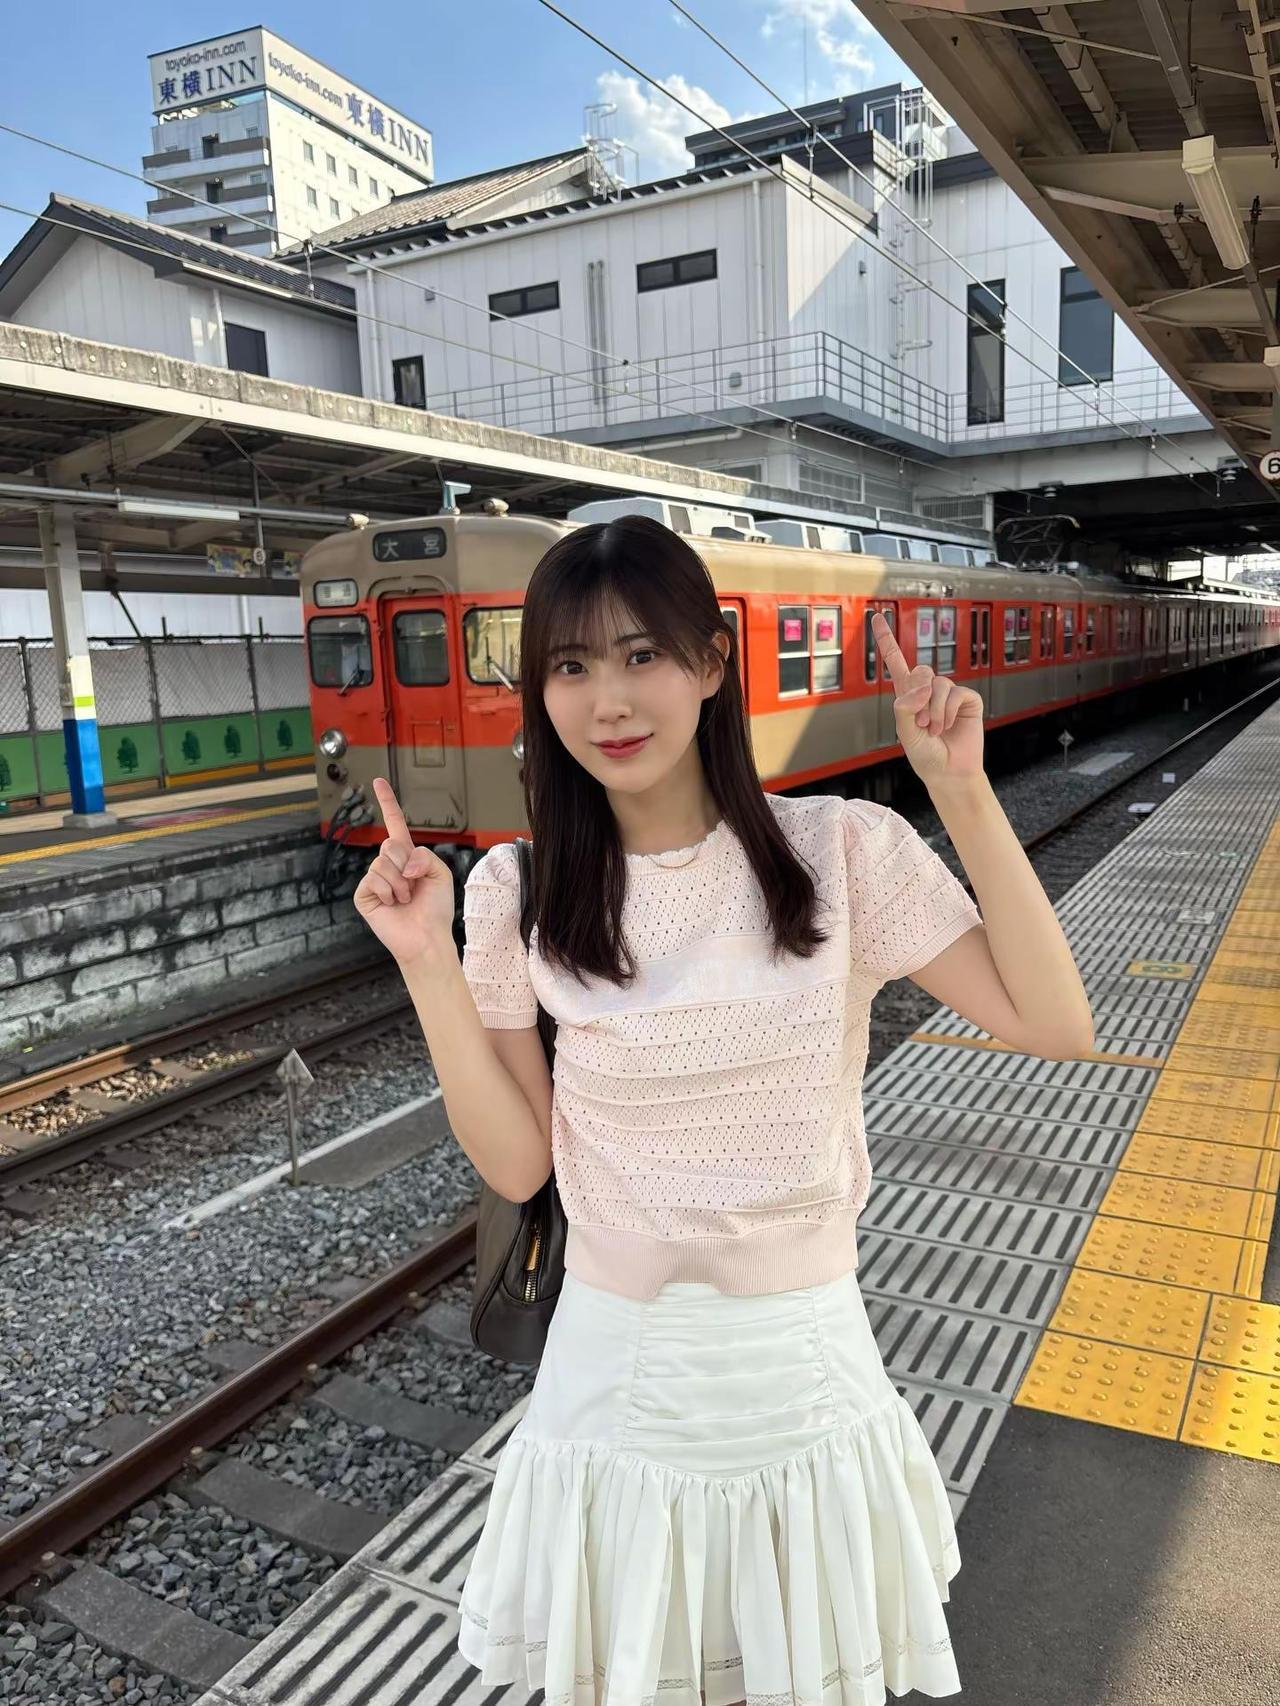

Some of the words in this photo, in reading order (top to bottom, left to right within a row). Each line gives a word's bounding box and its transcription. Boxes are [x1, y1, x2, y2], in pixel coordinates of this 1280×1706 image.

[165, 41, 246, 72] toyoko-inn.com
[158, 57, 257, 105] 東横INN
[269, 52, 343, 109] toyoko-inn.com
[345, 93, 428, 166] 東横INN
[1268, 457, 1280, 474] 6
[382, 533, 440, 559] 大宮
